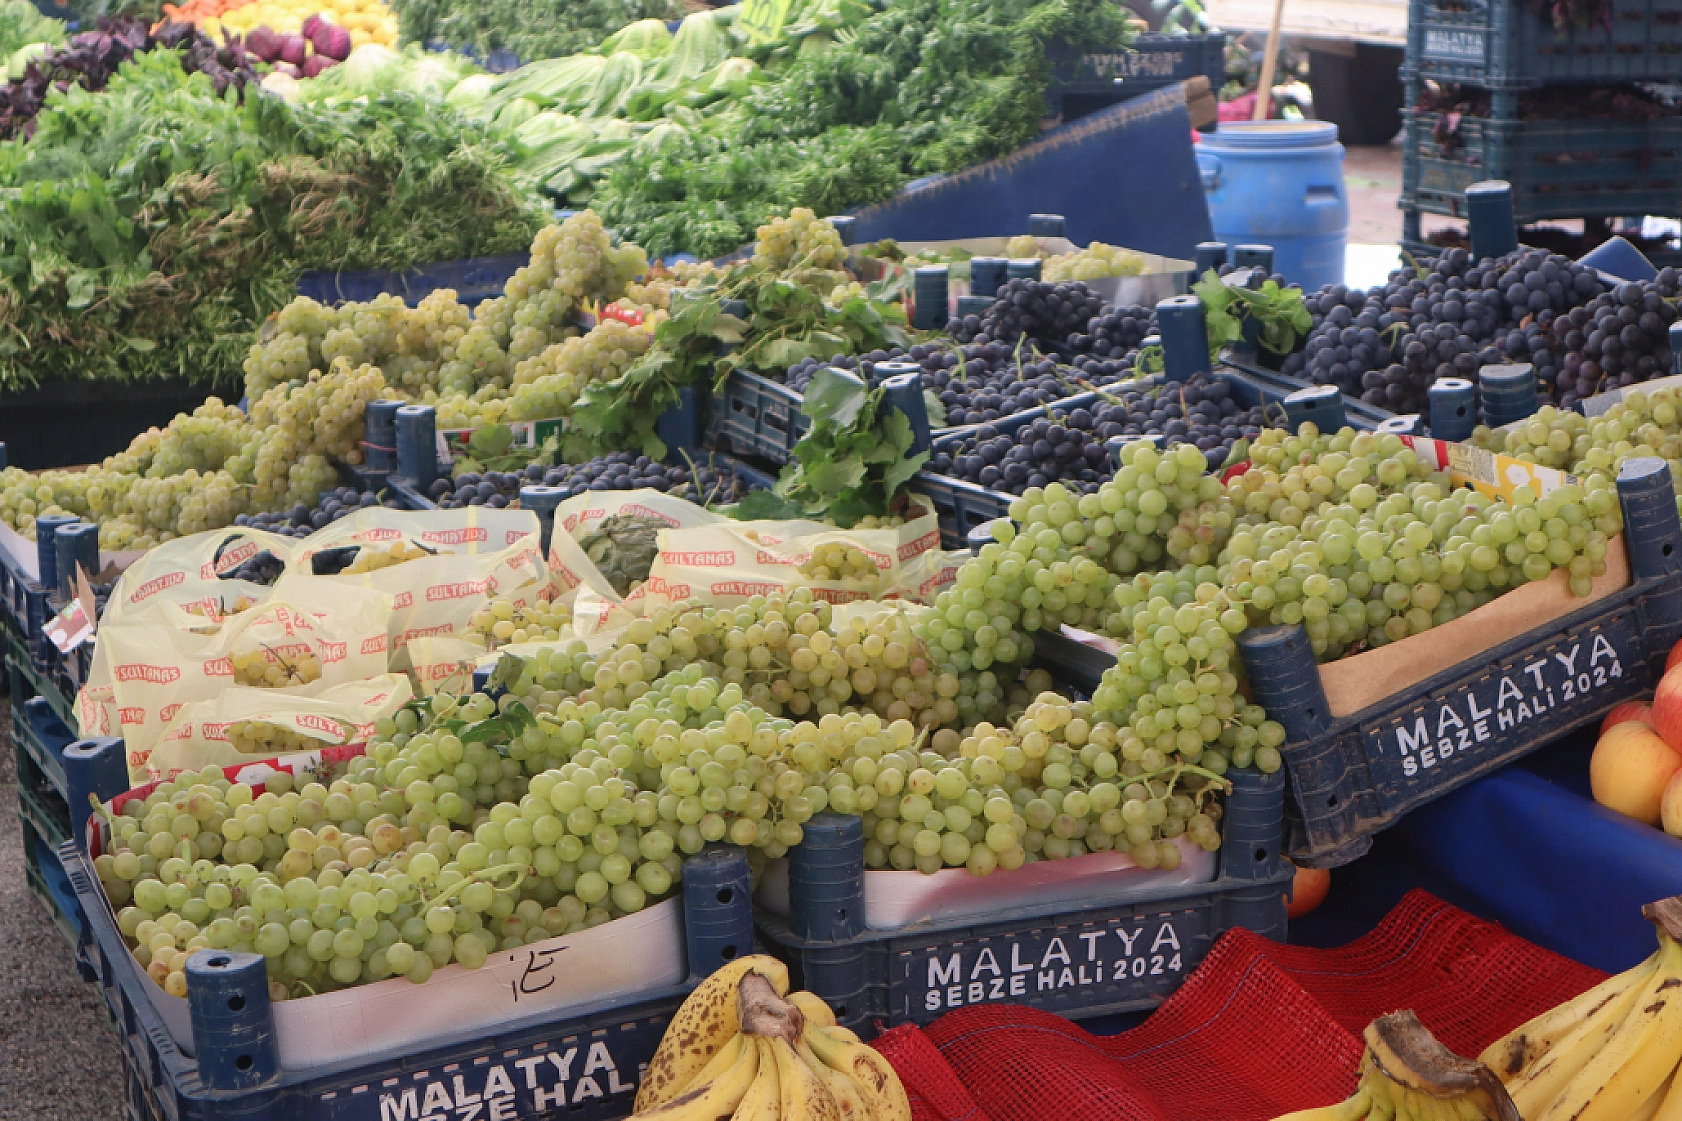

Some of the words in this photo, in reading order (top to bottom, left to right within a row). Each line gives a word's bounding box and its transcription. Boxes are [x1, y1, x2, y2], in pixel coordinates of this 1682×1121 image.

[113, 663, 181, 684] SULTANAS
[1395, 633, 1618, 755] MALATYA
[1402, 719, 1492, 776] SEBZE
[1561, 659, 1623, 701] 2024
[925, 974, 1027, 1010] SEBZE
[1112, 952, 1182, 980] 2024
[927, 922, 1181, 987] MALATYA
[379, 1041, 616, 1121] MALATYA
